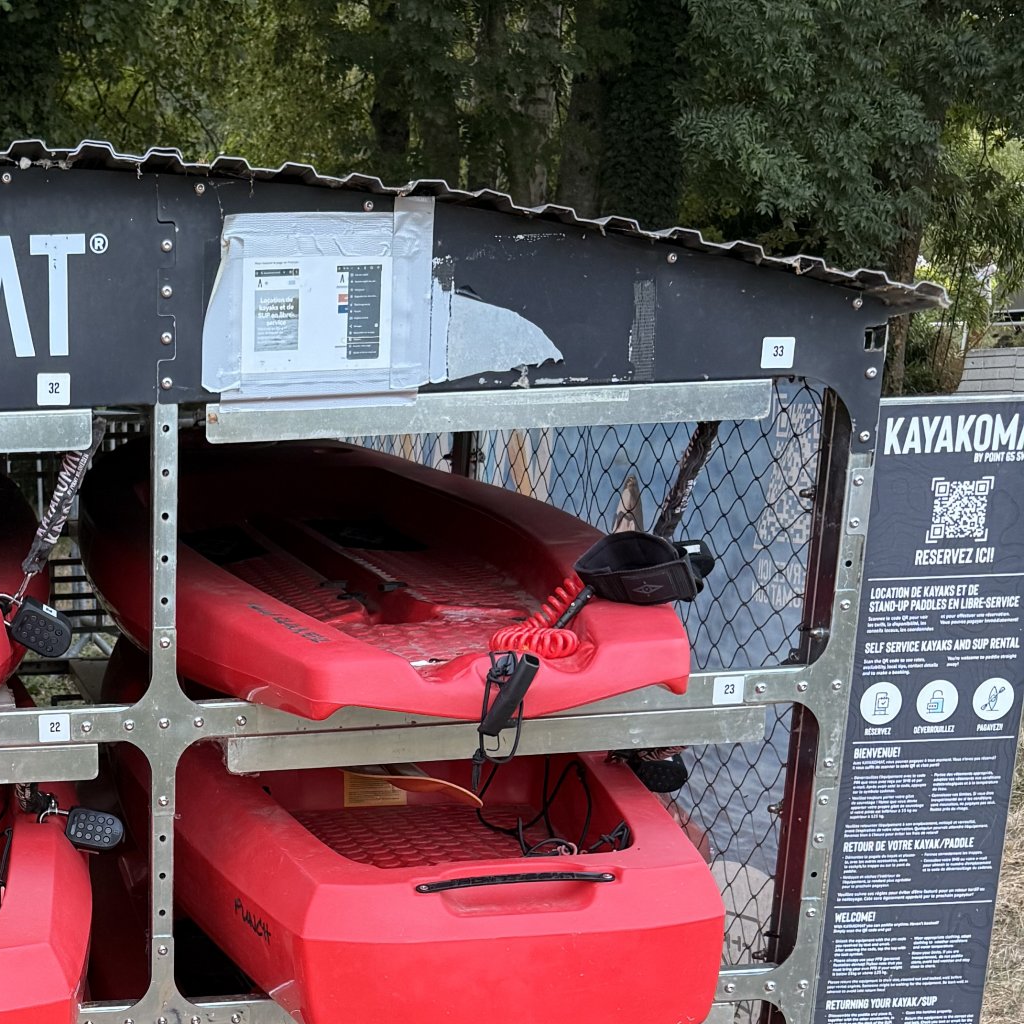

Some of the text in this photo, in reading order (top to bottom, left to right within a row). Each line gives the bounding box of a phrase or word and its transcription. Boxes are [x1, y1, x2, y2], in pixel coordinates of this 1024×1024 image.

[773, 345, 784, 357] 33
[48, 382, 60, 394] 32
[973, 452, 984, 463] BY
[984, 452, 1005, 463] POINT
[1006, 451, 1016, 462] 65
[915, 547, 995, 566] RESERVEZ ICI!
[871, 584, 980, 599] LOCATION DE KAYAKS ET DE
[869, 596, 1021, 613] STAND-UP PADDLES EN LIBRE-SERVICE
[864, 637, 1020, 654] SELF SERVICE KAYAKS AND SUP RENTAL
[724, 683, 735, 695] 23
[49, 721, 61, 733] 22
[853, 746, 901, 759] BIENVENUE!
[843, 837, 975, 853] RETOUR DE VOTRE KAYAK/PADDLE
[234, 897, 272, 946] PUNCH
[835, 911, 876, 923] WELCOME!
[826, 996, 938, 1011] RETURNING YOUR KAYAK/SUP
